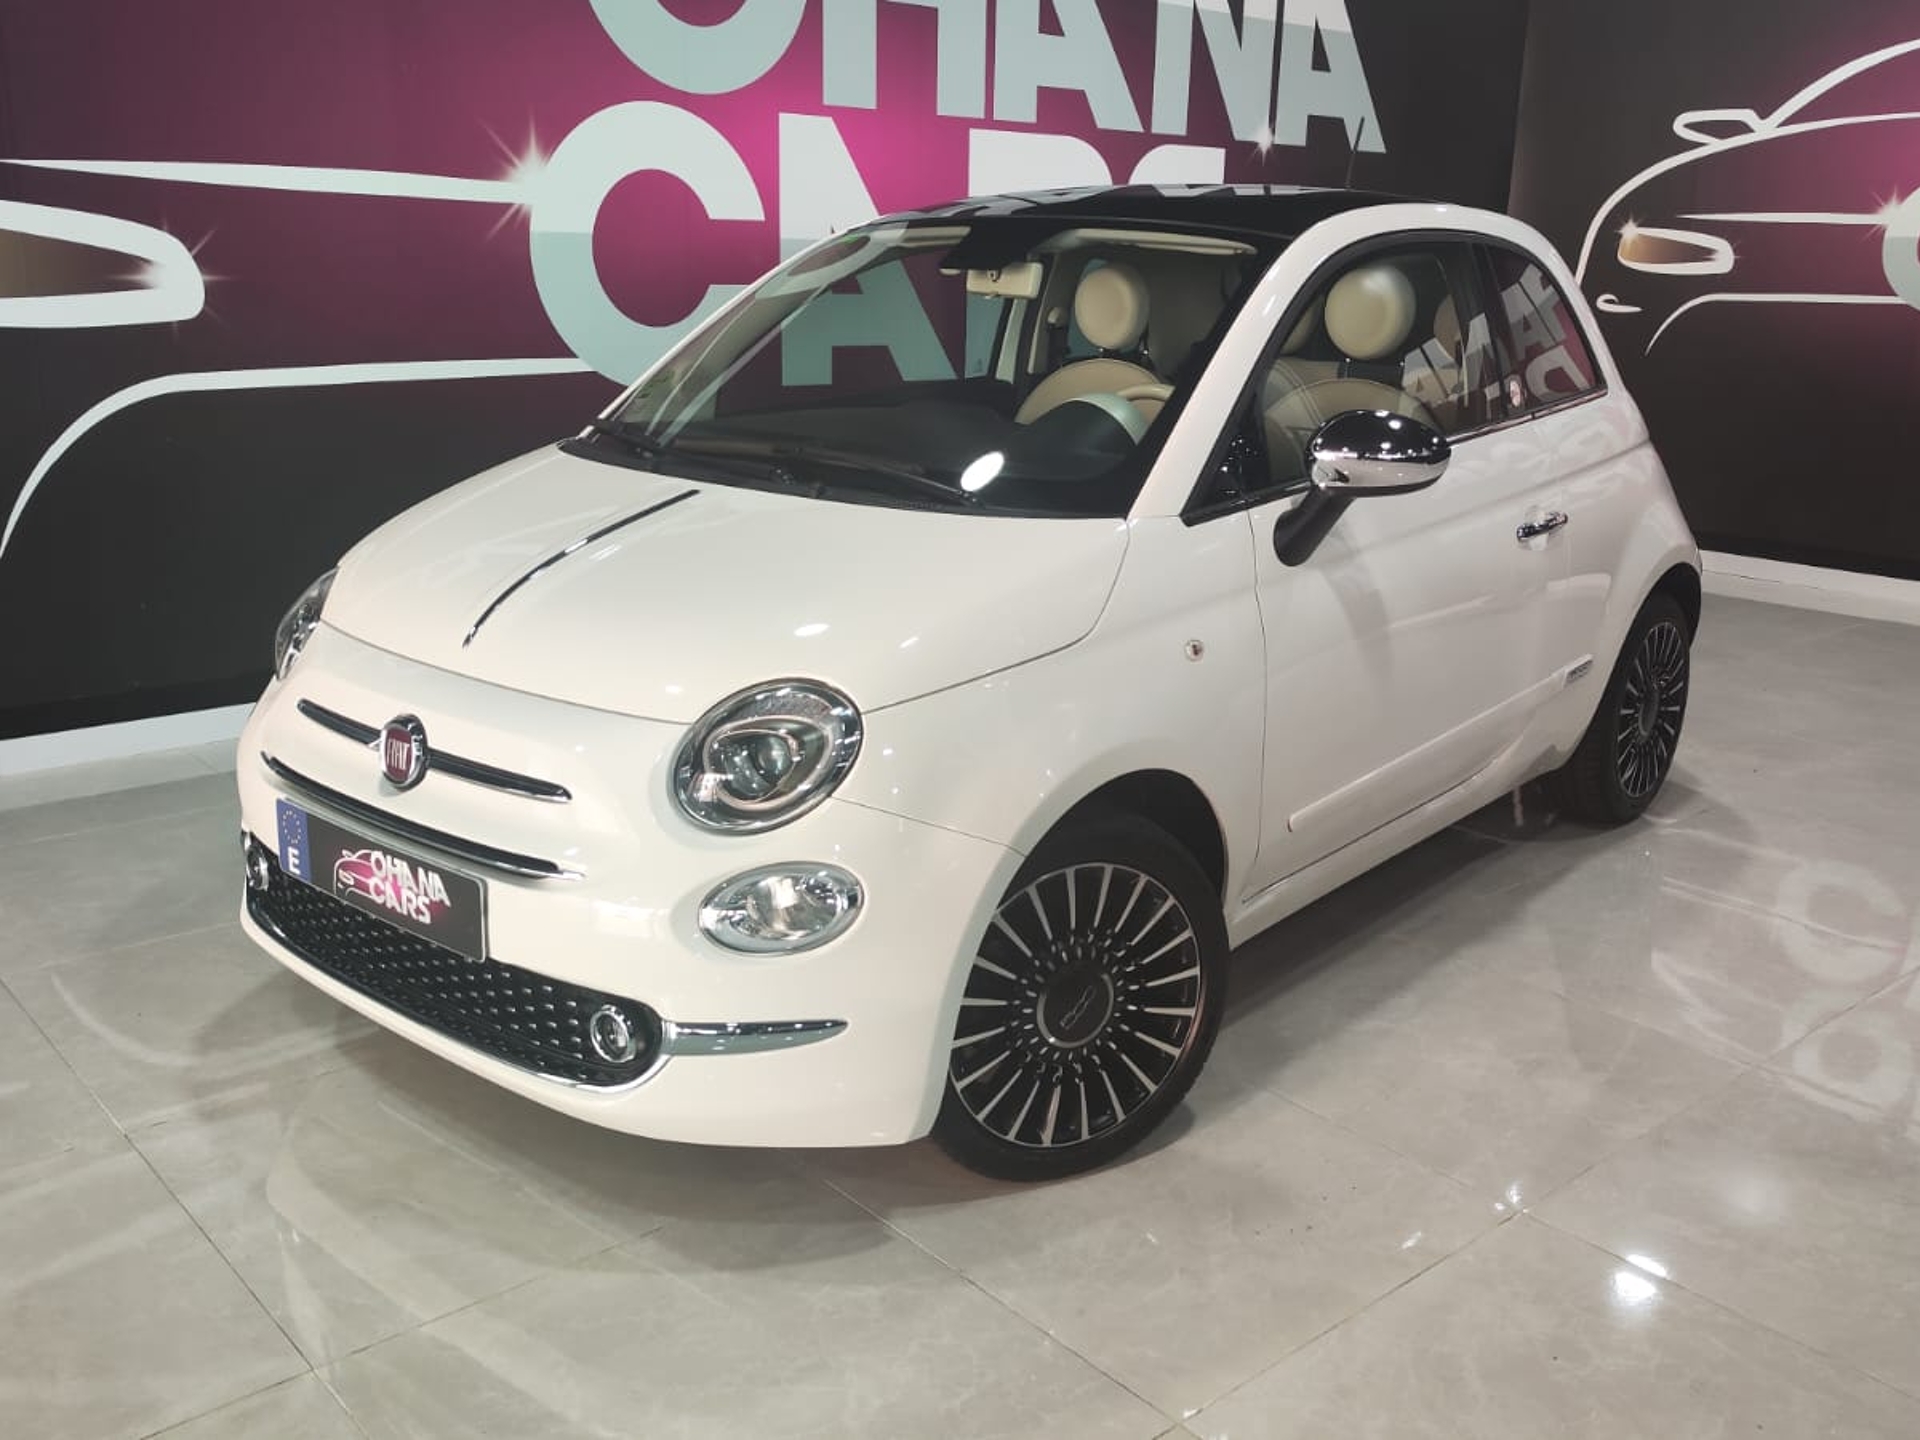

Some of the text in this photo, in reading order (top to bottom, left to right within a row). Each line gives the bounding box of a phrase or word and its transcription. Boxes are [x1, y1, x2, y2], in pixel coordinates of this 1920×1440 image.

[529, 100, 1226, 388] CA
[386, 737, 411, 771] FIAT
[287, 846, 301, 874] E
[370, 850, 451, 908] OHANA
[368, 878, 432, 925] CARS
